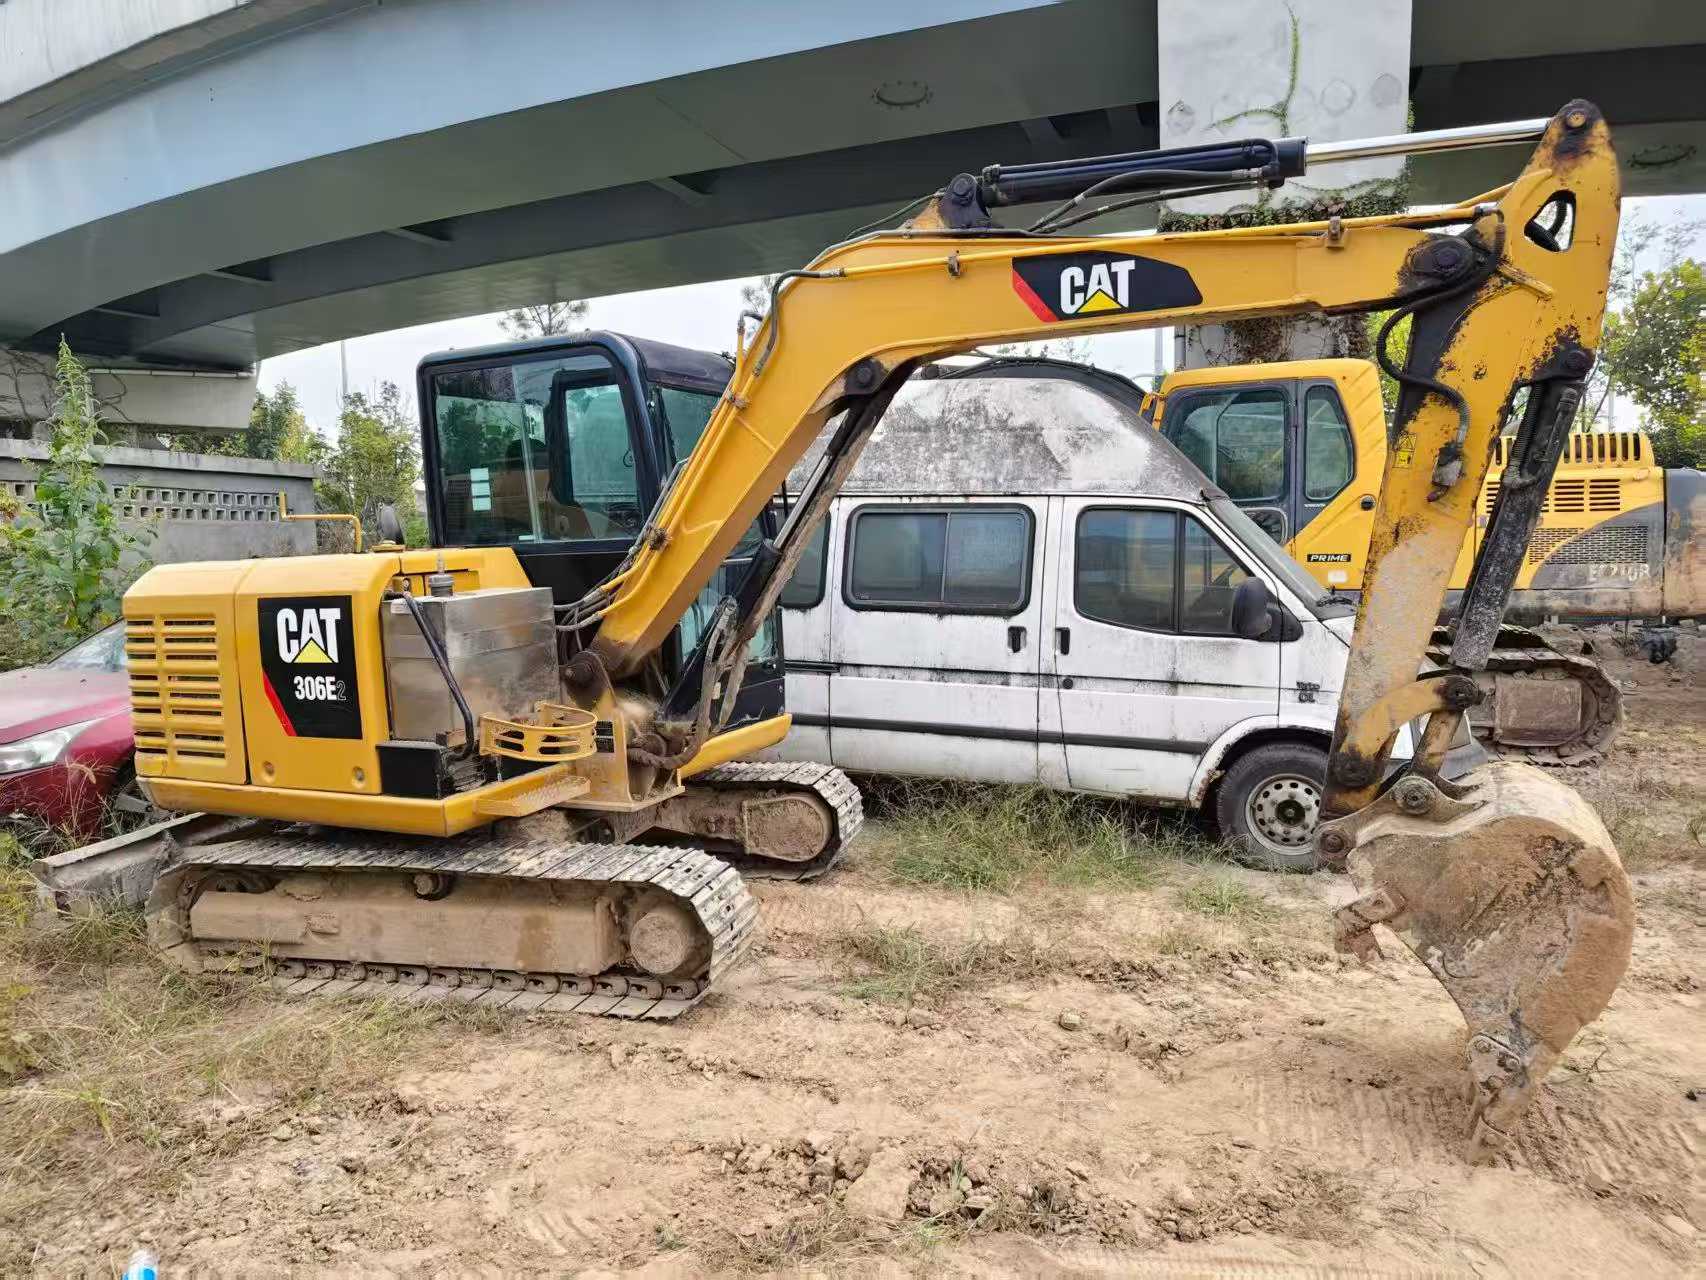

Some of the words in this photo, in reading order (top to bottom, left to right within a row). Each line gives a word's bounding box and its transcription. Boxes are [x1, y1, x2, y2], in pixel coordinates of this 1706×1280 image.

[1060, 260, 1135, 314] CAT
[1310, 554, 1349, 562] PRIME
[276, 607, 341, 663] CAT
[293, 675, 346, 701] 306E2
